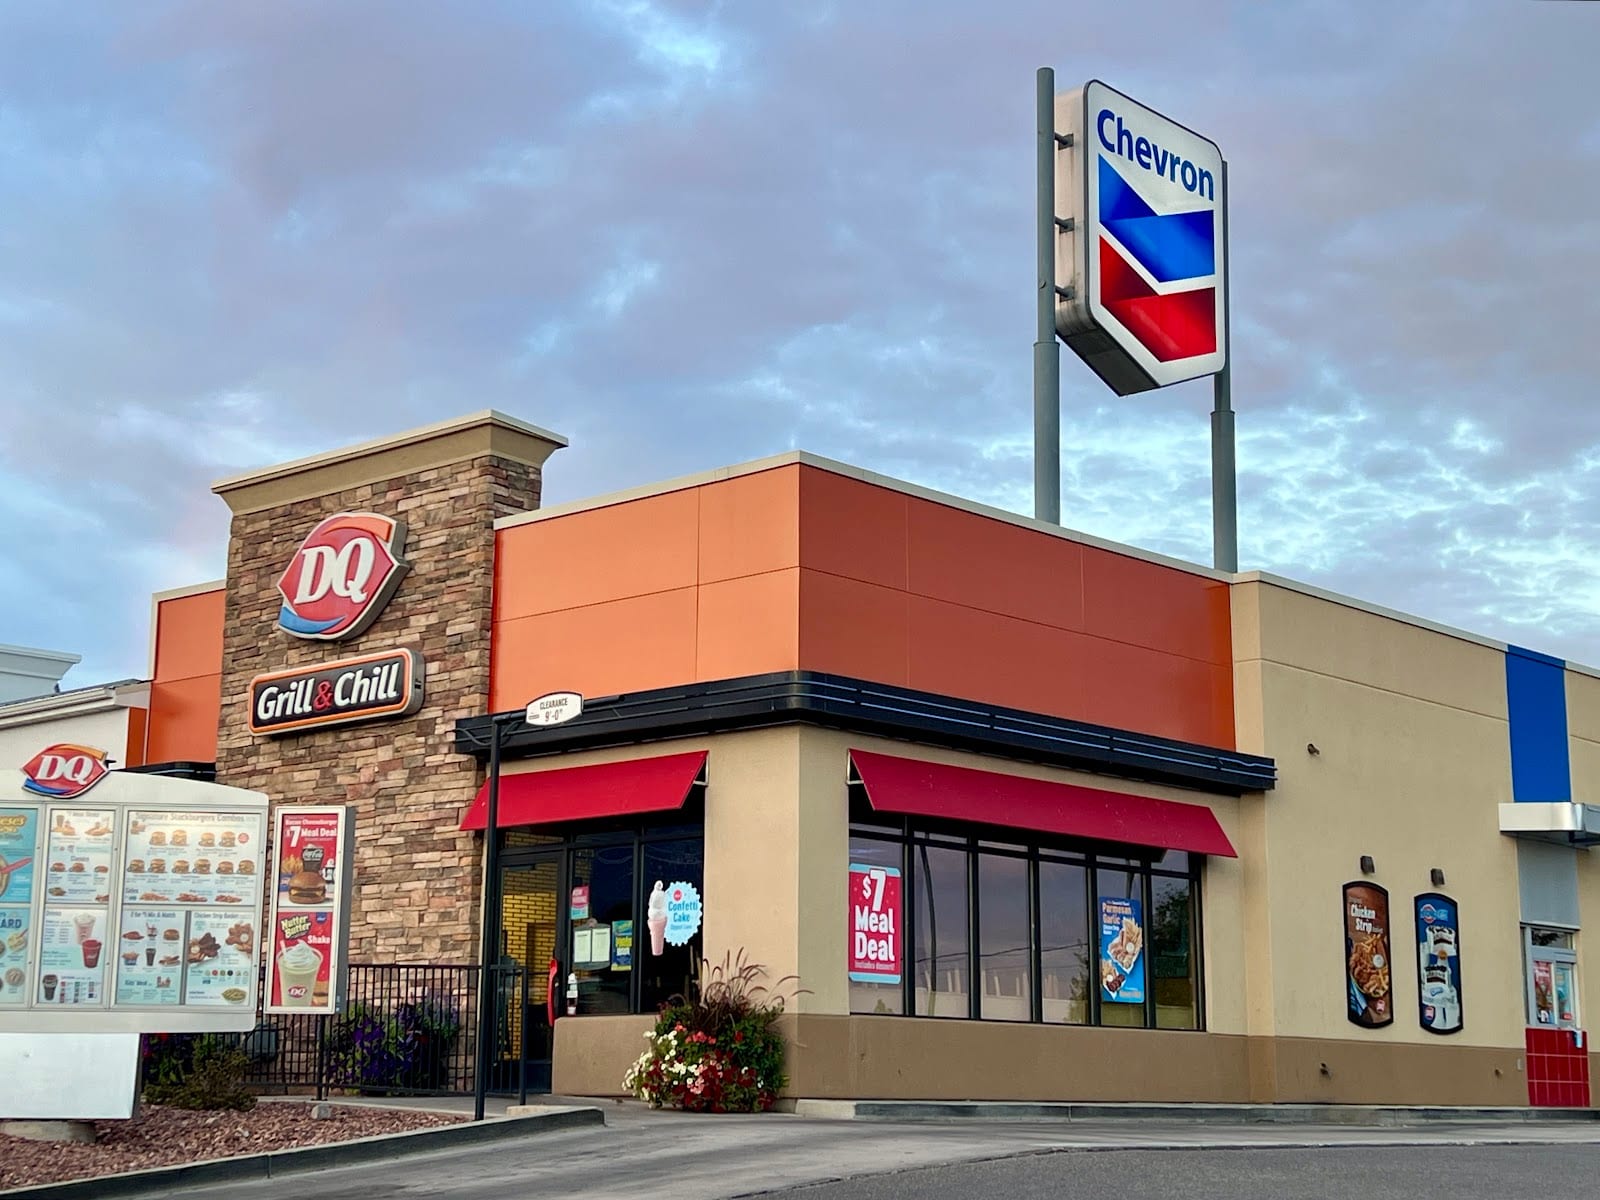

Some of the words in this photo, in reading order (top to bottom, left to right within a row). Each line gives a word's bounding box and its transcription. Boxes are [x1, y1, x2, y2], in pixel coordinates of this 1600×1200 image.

[1097, 109, 1214, 201] Chevron
[294, 537, 375, 605] DQ
[540, 697, 568, 710] CLEARANCE
[34, 755, 94, 785] DQ
[301, 828, 319, 837] Meal
[320, 828, 337, 837] Deal
[862, 869, 886, 912] $7
[668, 900, 698, 911] Confetti
[1351, 903, 1375, 919] Chicken
[281, 915, 309, 930] Nutter
[673, 912, 690, 922] Cake
[855, 905, 895, 934] Meal
[1355, 917, 1372, 934] Strip
[285, 922, 312, 939] Butter
[307, 935, 330, 944] Shake
[855, 931, 895, 962] Deal
